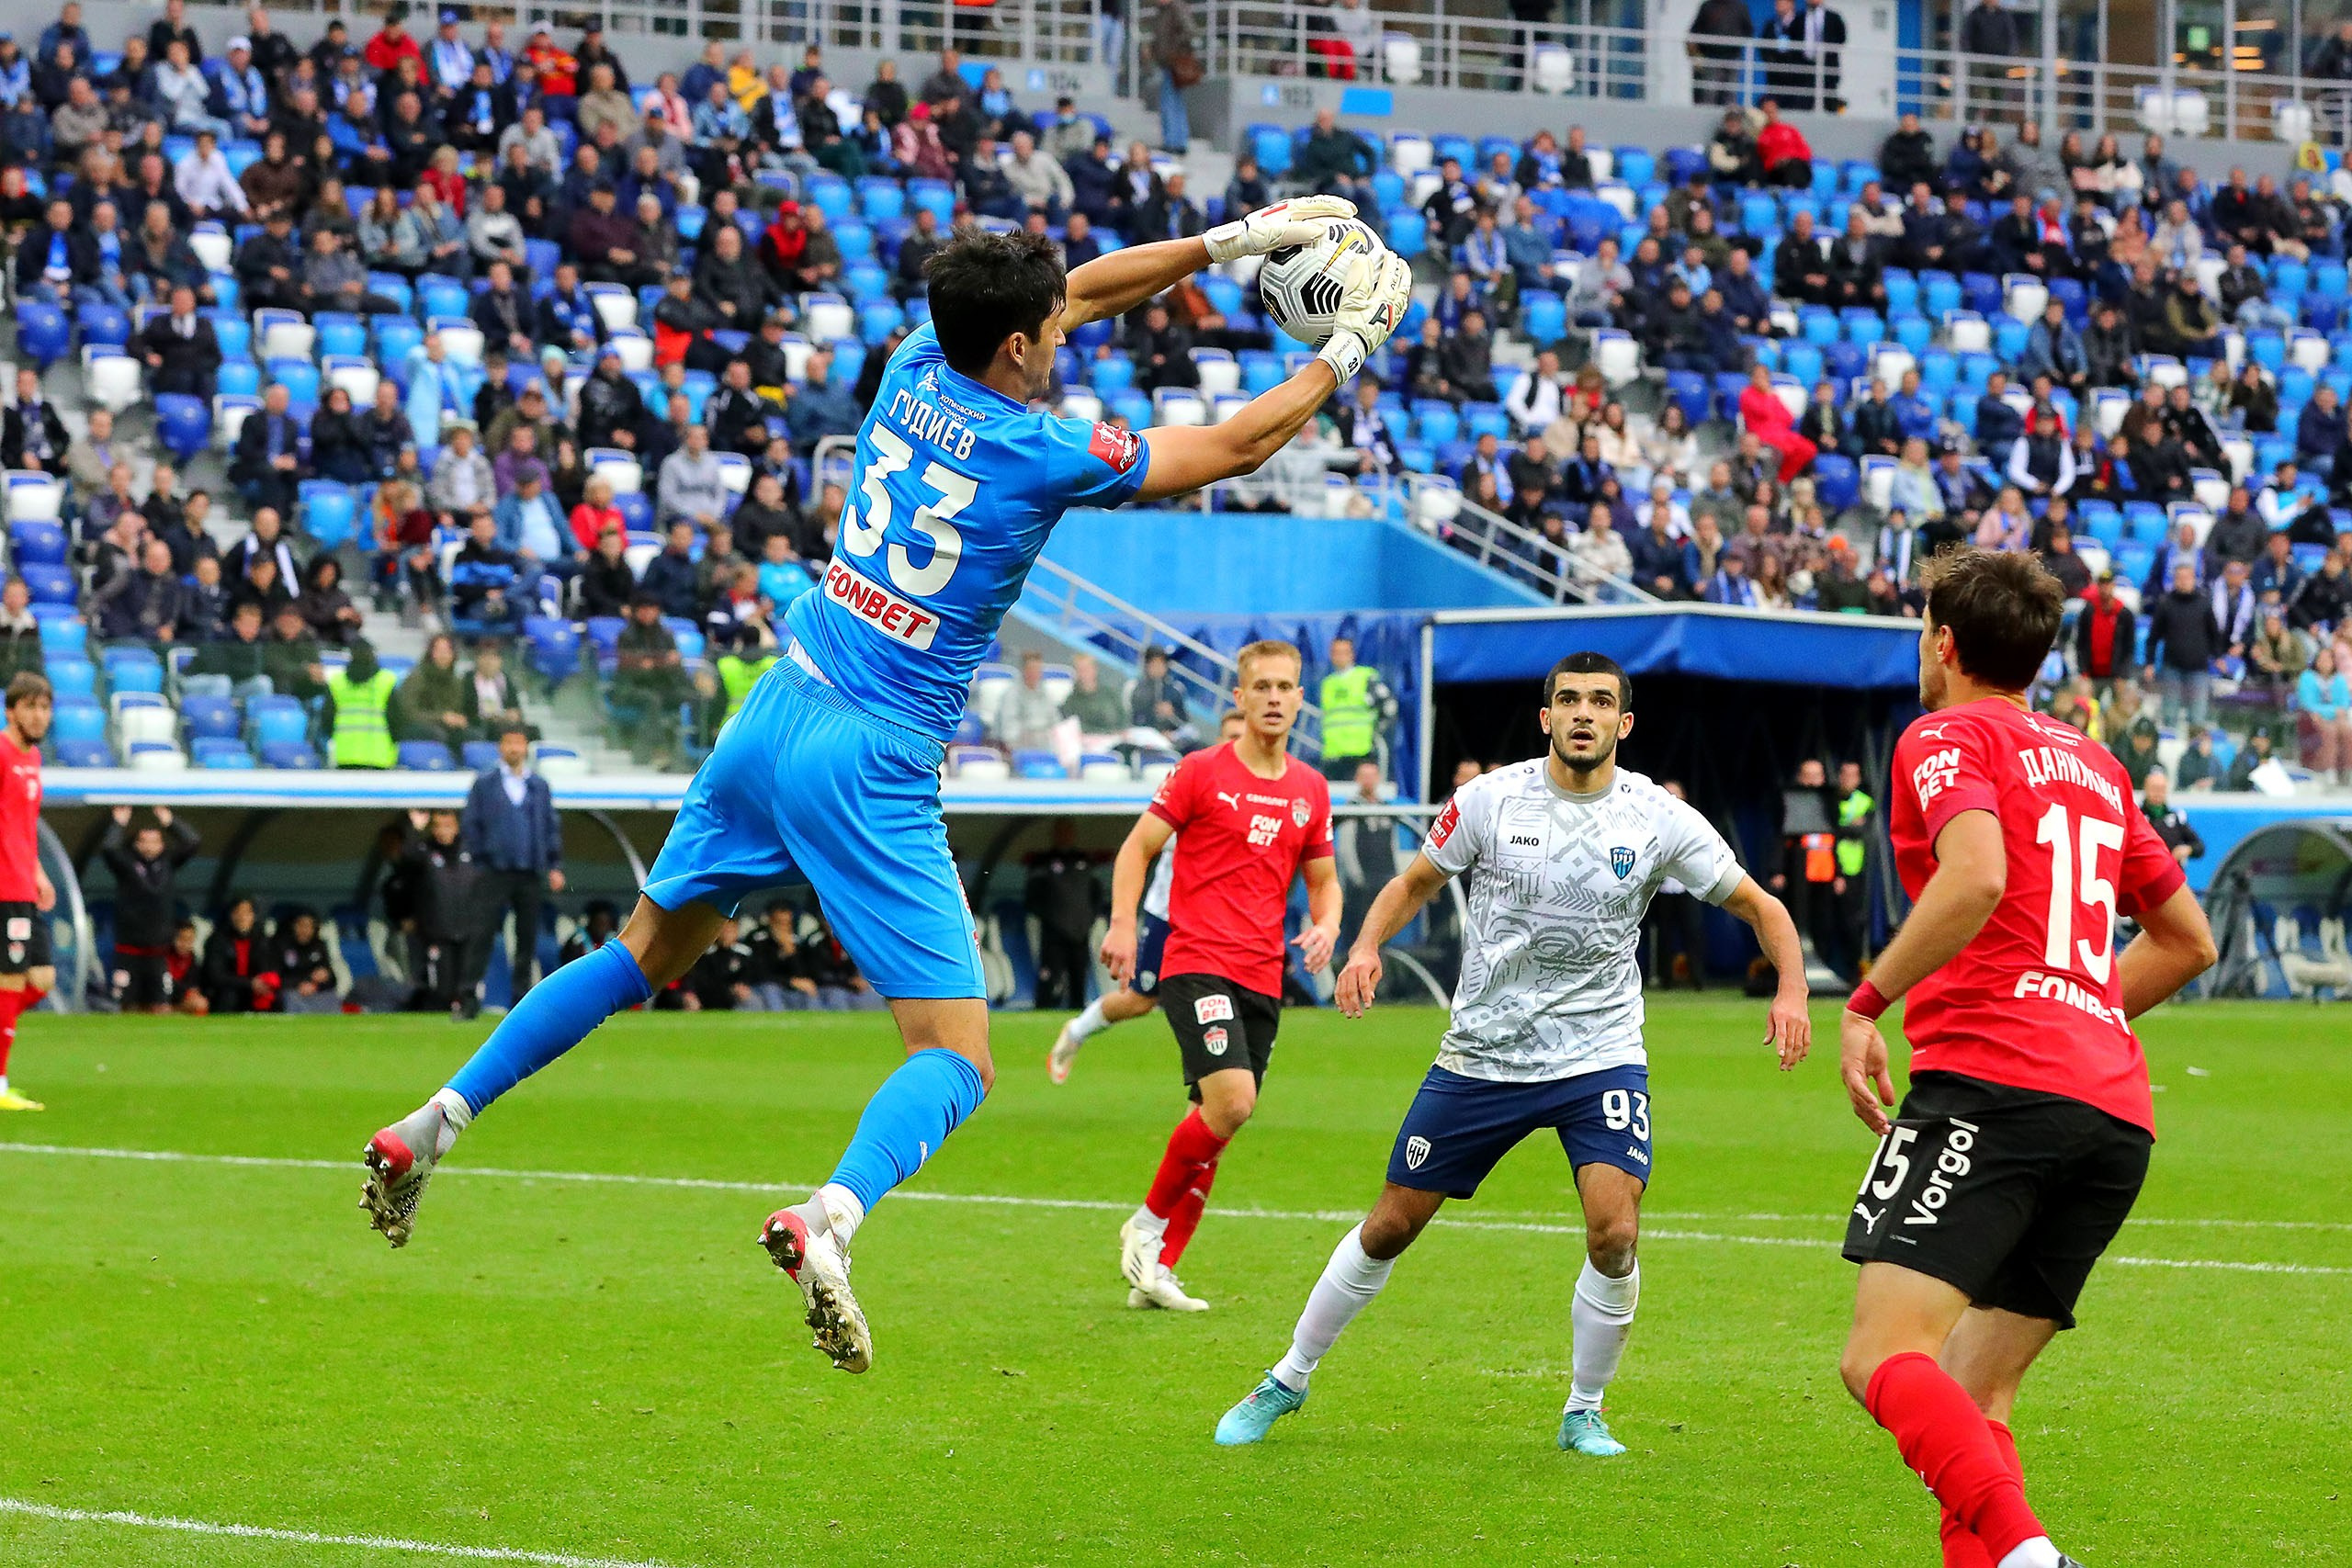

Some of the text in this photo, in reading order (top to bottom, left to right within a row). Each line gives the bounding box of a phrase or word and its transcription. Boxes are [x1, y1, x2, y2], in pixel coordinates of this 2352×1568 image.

[888, 388, 977, 460] ГУДИЕВ
[843, 421, 979, 597] 33
[825, 565, 932, 638] FONBET
[1913, 748, 1961, 792] FON
[1917, 768, 1960, 812] BET
[1247, 829, 1277, 846] BET
[1250, 814, 1283, 832] FON
[1510, 835, 1540, 847] JAKO
[2036, 802, 2124, 985] 15
[1200, 998, 1227, 1010] FON
[1203, 1008, 1227, 1021] BET
[1602, 1089, 1650, 1142] 93
[1626, 1145, 1649, 1166] JAKO
[1904, 1117, 1980, 1224] Vorgol
